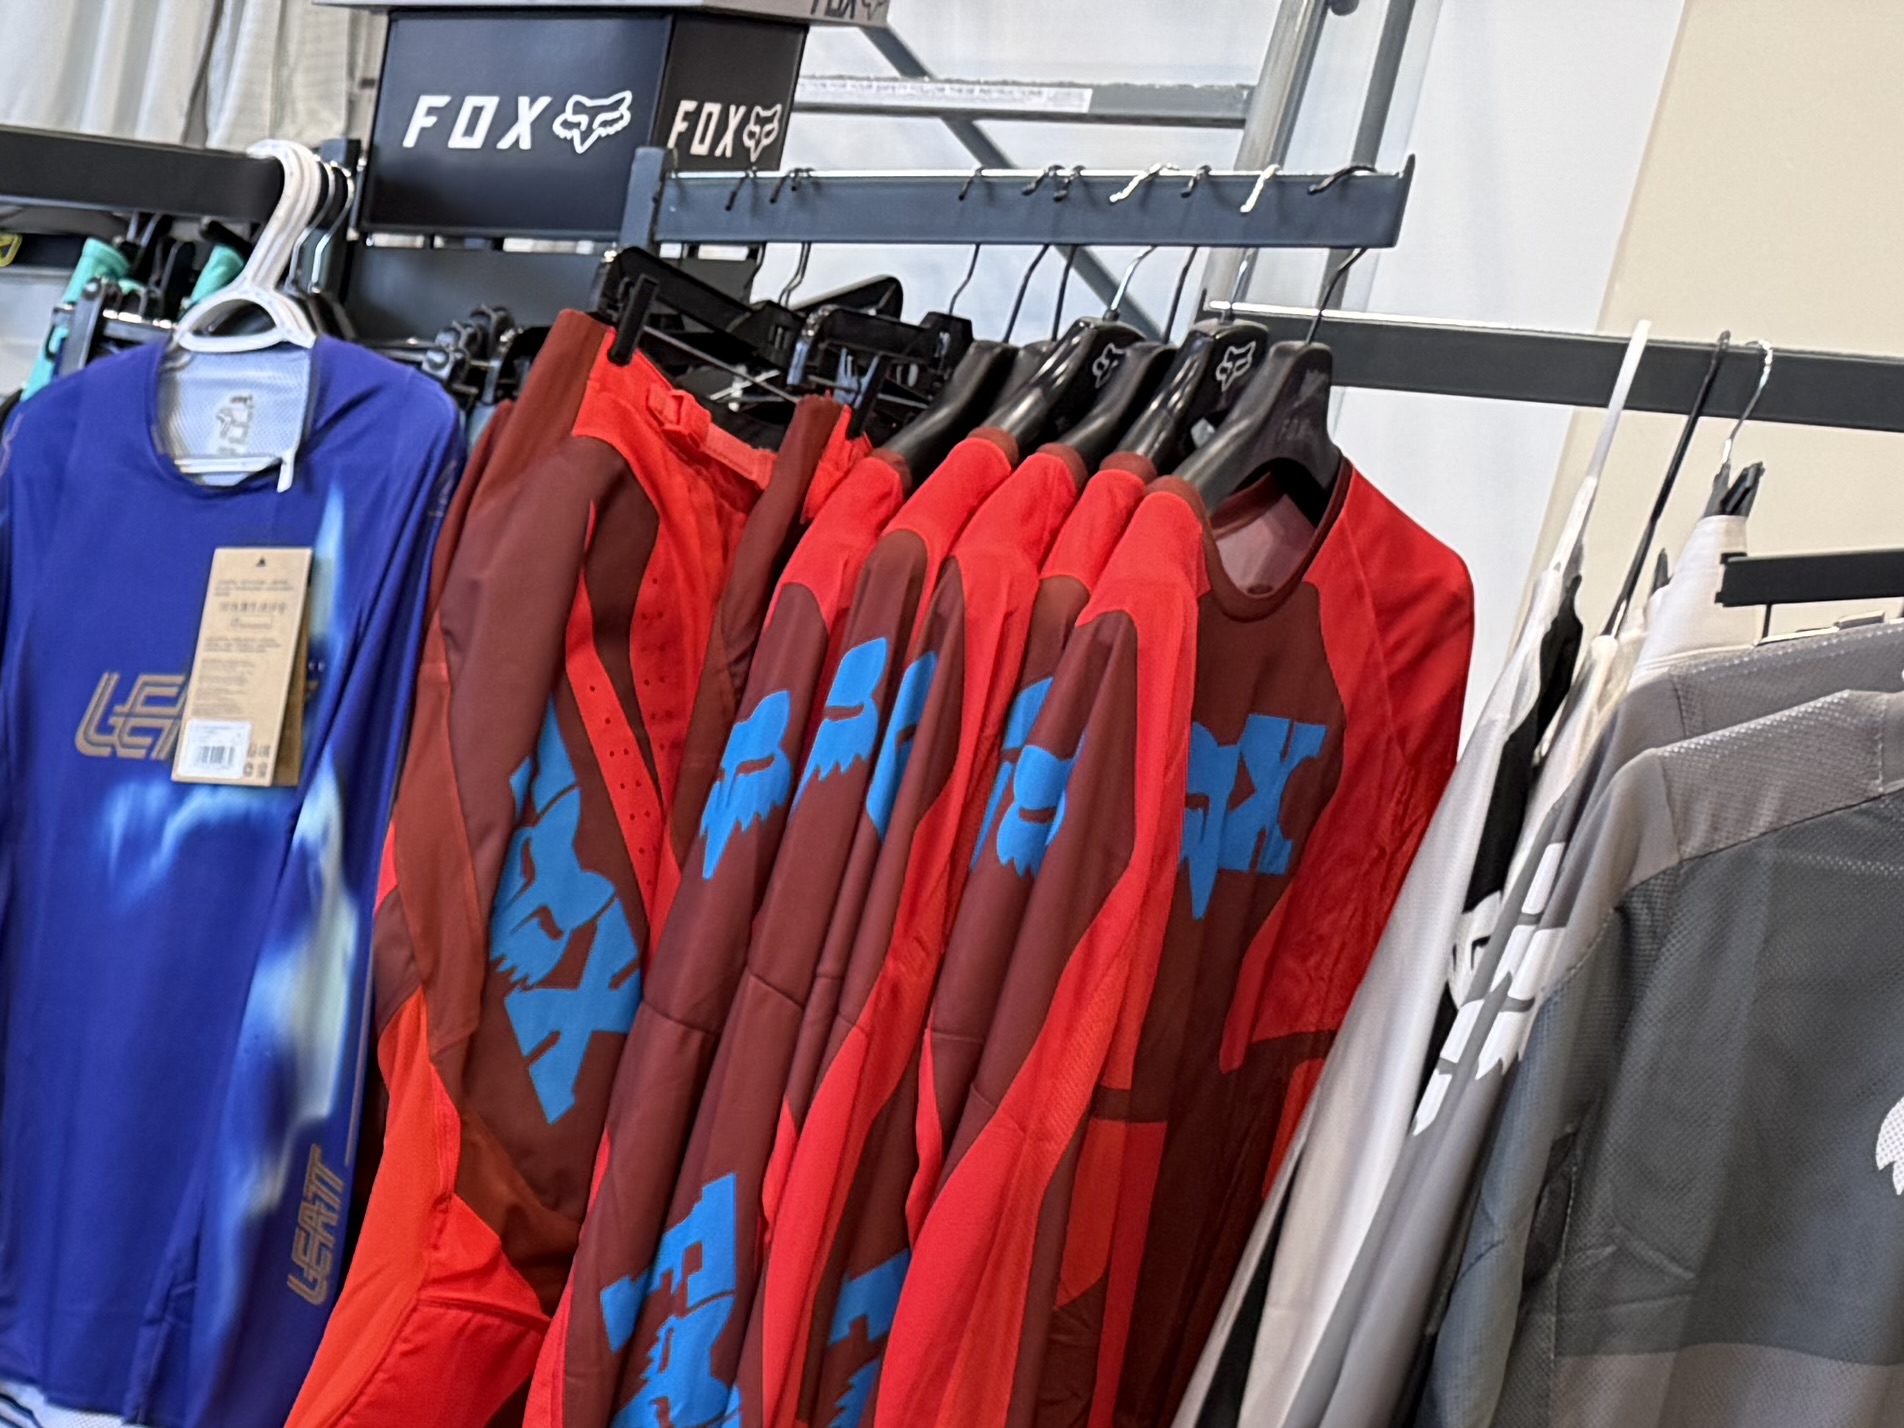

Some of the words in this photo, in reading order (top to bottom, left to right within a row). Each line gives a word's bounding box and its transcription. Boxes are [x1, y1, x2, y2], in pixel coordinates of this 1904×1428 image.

[403, 95, 552, 151] FOX
[666, 99, 747, 159] FOX
[286, 1143, 346, 1306] LEATT
